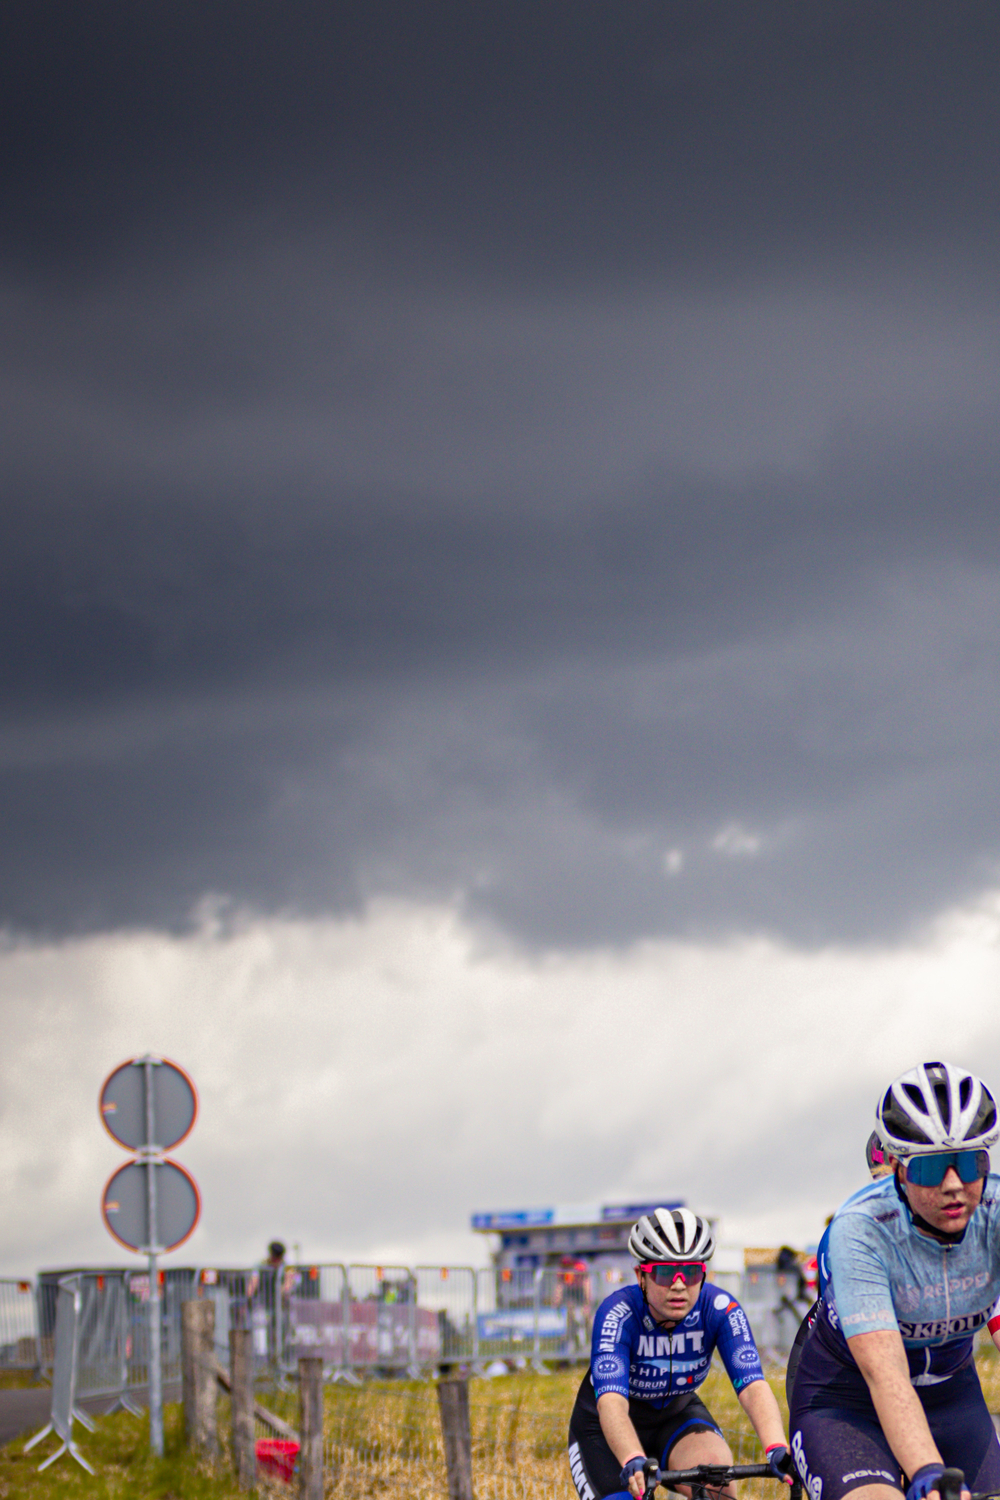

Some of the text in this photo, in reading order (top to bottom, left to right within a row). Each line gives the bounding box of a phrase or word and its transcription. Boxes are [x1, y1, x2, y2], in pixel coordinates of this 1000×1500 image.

[601, 1301, 631, 1344] LEBRUN
[728, 1312, 741, 1337] Clarke
[736, 1309, 751, 1342] Osborne
[637, 1330, 704, 1357] NMT
[630, 1359, 707, 1376] SHIPPING
[629, 1377, 667, 1389] LEBRUN
